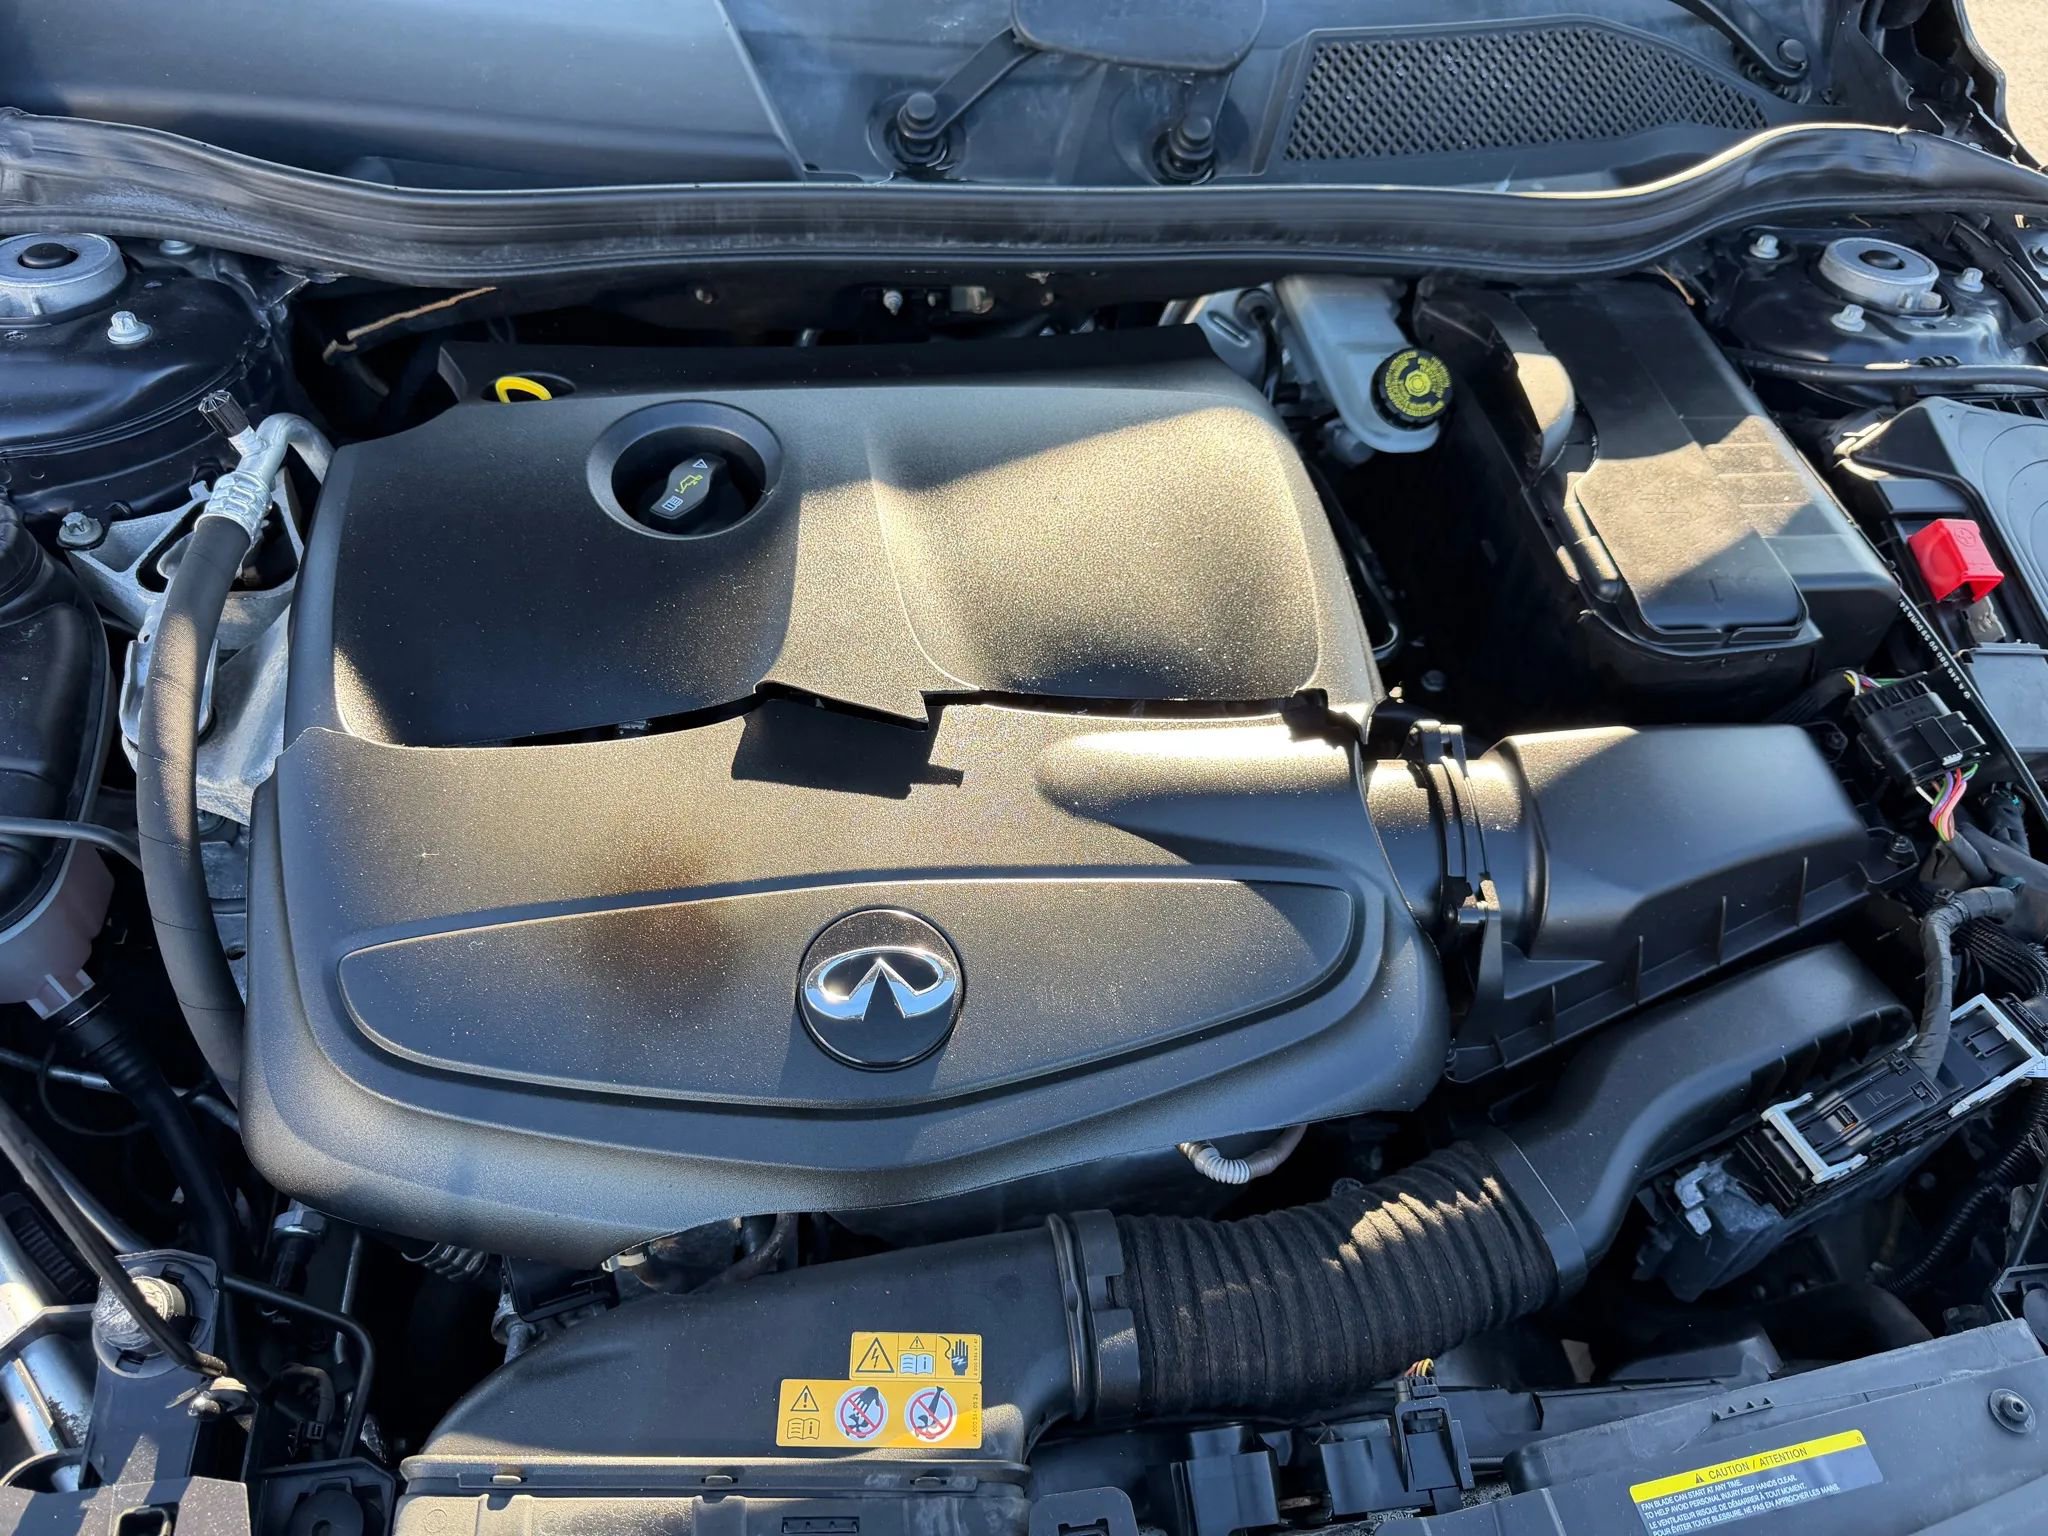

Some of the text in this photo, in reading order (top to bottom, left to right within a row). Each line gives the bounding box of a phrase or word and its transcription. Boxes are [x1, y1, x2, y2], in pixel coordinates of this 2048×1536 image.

[1709, 1462, 1750, 1479] CAUTION
[1760, 1448, 1807, 1467] ATTENTION
[1641, 1479, 1743, 1511] FAN BLADE CAN START AT ANY TIME.
[1644, 1511, 1654, 1519] TO
[1654, 1507, 1670, 1517] HELP
[1671, 1502, 1689, 1513] AVOID
[1689, 1495, 1721, 1507] PERSONAL
[1755, 1479, 1777, 1491] HANDS
[1777, 1475, 1797, 1485] CLEAR.
[1649, 1521, 1658, 1529] LE
[1657, 1512, 1696, 1526] VENTILATEUR
[1696, 1505, 1719, 1517] RISQUE
[1718, 1503, 1728, 1511] DE
[1727, 1495, 1760, 1509] DÉMARRER
[1764, 1489, 1781, 1498] TOUT
[1781, 1483, 1807, 1494] MOMENT.
[1671, 1520, 1692, 1533] ÉVITER
[1691, 1517, 1712, 1528] TOUTE
[1711, 1509, 1744, 1522] BLESSURE,
[1743, 1506, 1753, 1514] NE
[1752, 1503, 1765, 1512] PAS
[1764, 1501, 1774, 1509] EN
[1775, 1492, 1809, 1506] APPROCHER
[1808, 1488, 1821, 1497] LES
